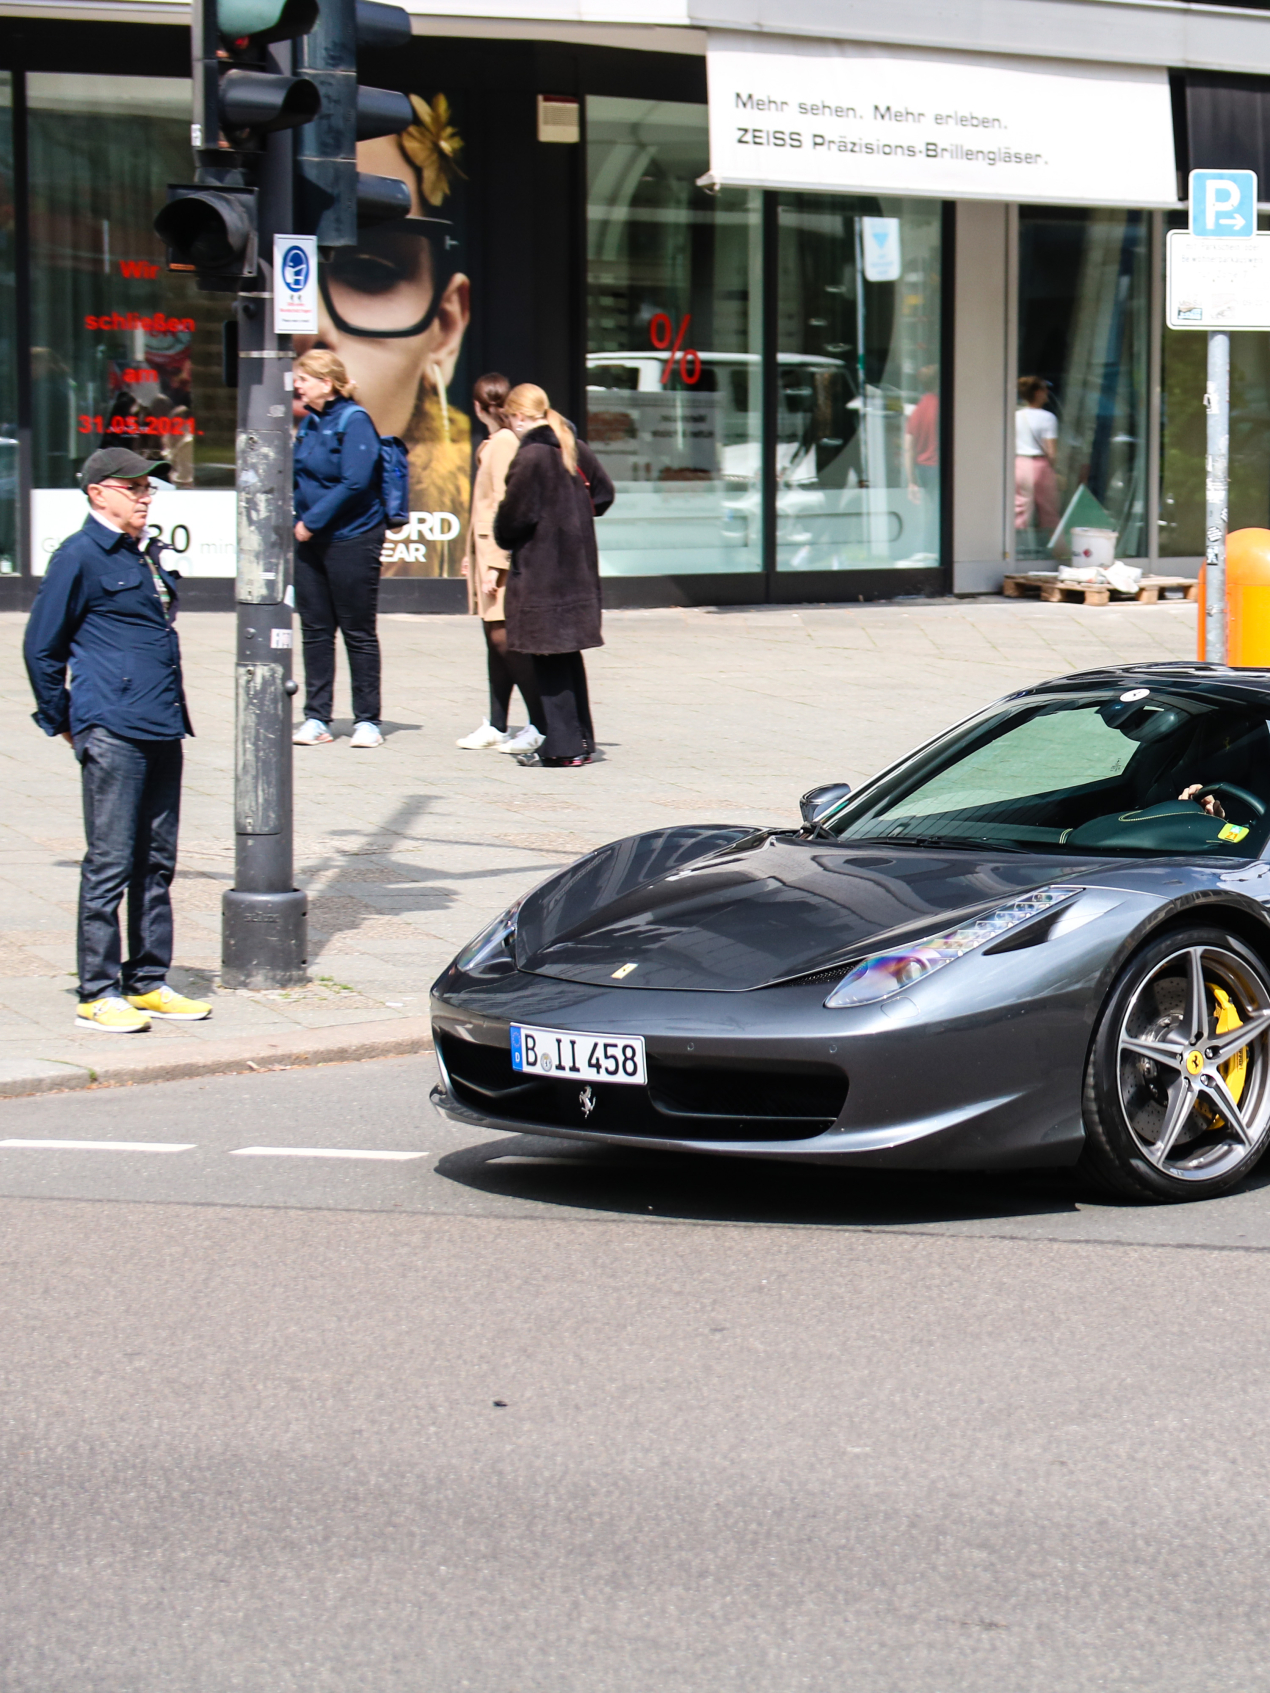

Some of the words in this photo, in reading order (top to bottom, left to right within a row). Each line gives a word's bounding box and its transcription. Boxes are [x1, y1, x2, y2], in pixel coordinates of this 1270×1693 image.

[735, 92, 789, 112] Mehr
[797, 99, 863, 120] sehen.
[873, 104, 926, 125] Mehr
[934, 109, 1008, 130] erleben.
[736, 127, 803, 148] ZEISS
[1205, 179, 1241, 230] P
[119, 260, 160, 279] Wir
[84, 311, 196, 332] schließen
[123, 367, 159, 383] am
[77, 414, 205, 436] 31.05.2021.
[1225, 831, 1239, 840] 21
[514, 1052, 521, 1064] D
[525, 1033, 538, 1067] B
[555, 1037, 580, 1073] II
[587, 1041, 638, 1077] 458
